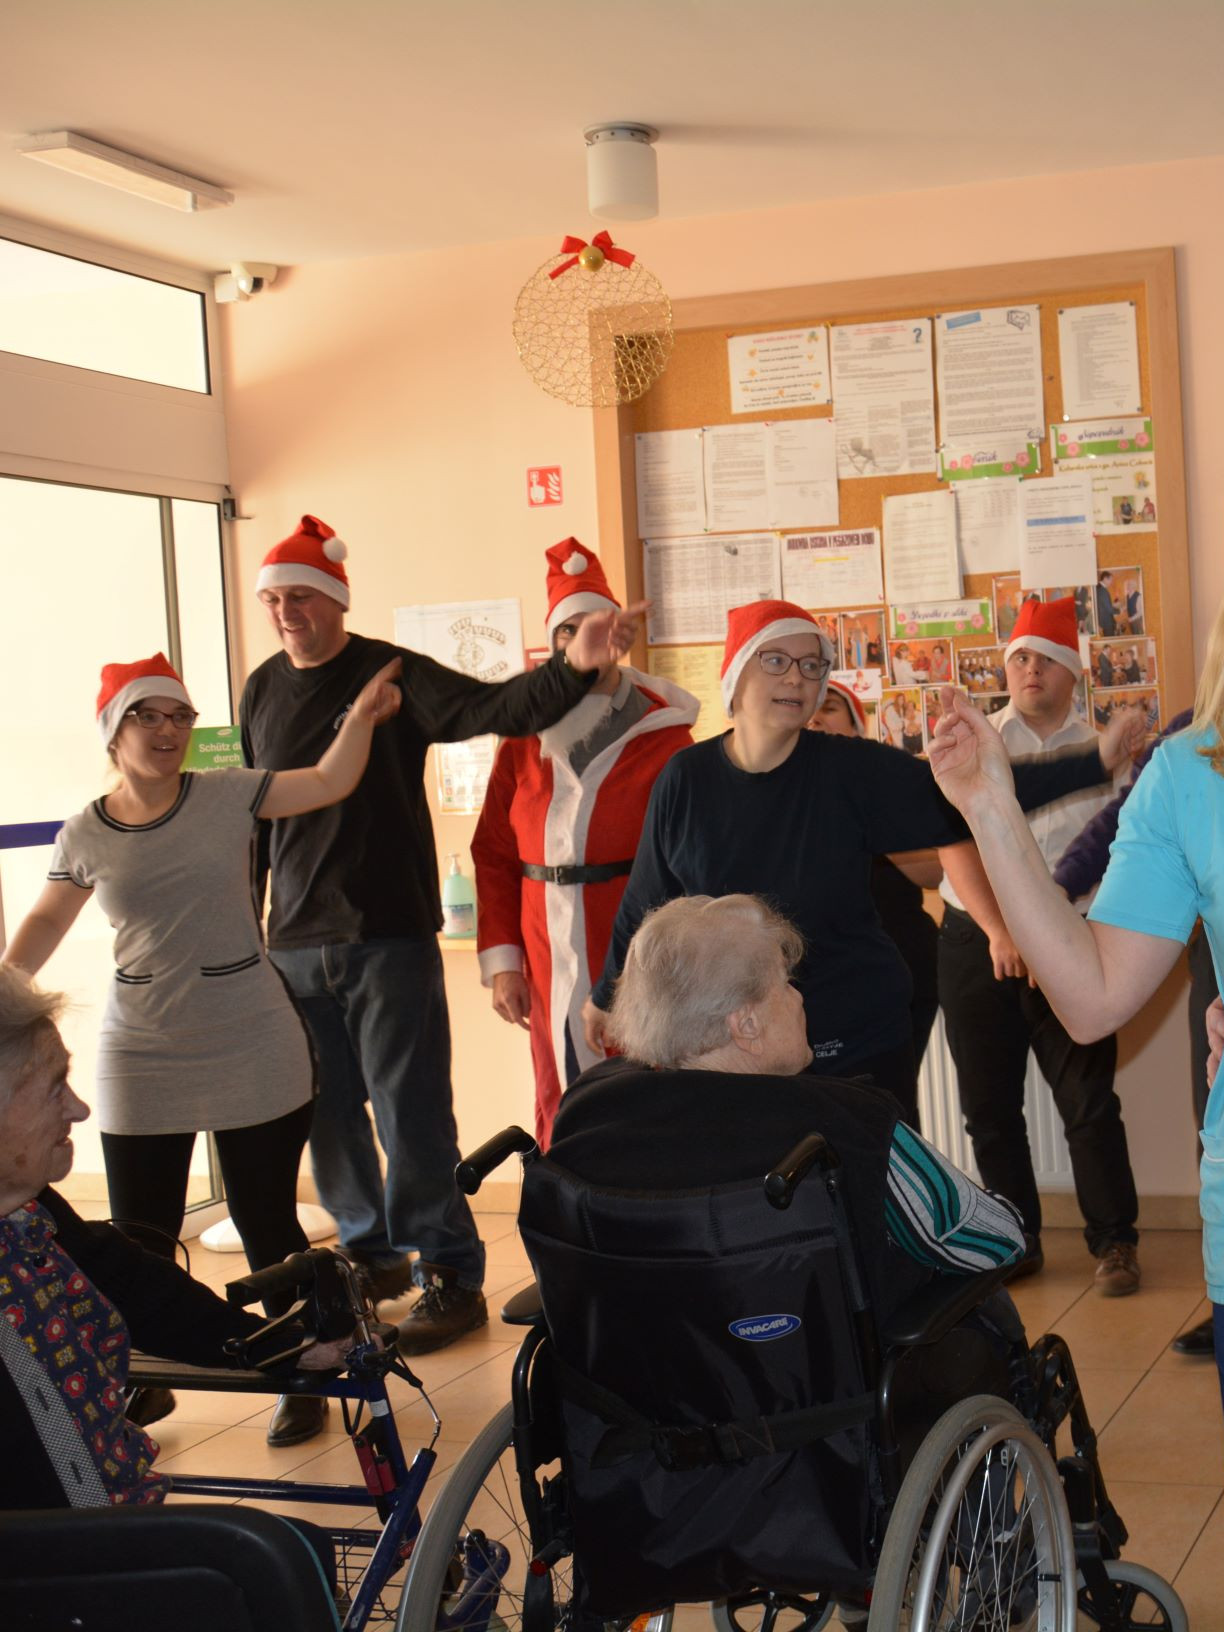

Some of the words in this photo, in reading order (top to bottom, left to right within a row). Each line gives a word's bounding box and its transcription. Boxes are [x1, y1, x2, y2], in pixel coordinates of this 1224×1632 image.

[198, 743, 230, 753] Schütz
[214, 753, 240, 763] durch
[815, 1049, 838, 1058] CELJE
[738, 1316, 788, 1336] INVACARE
